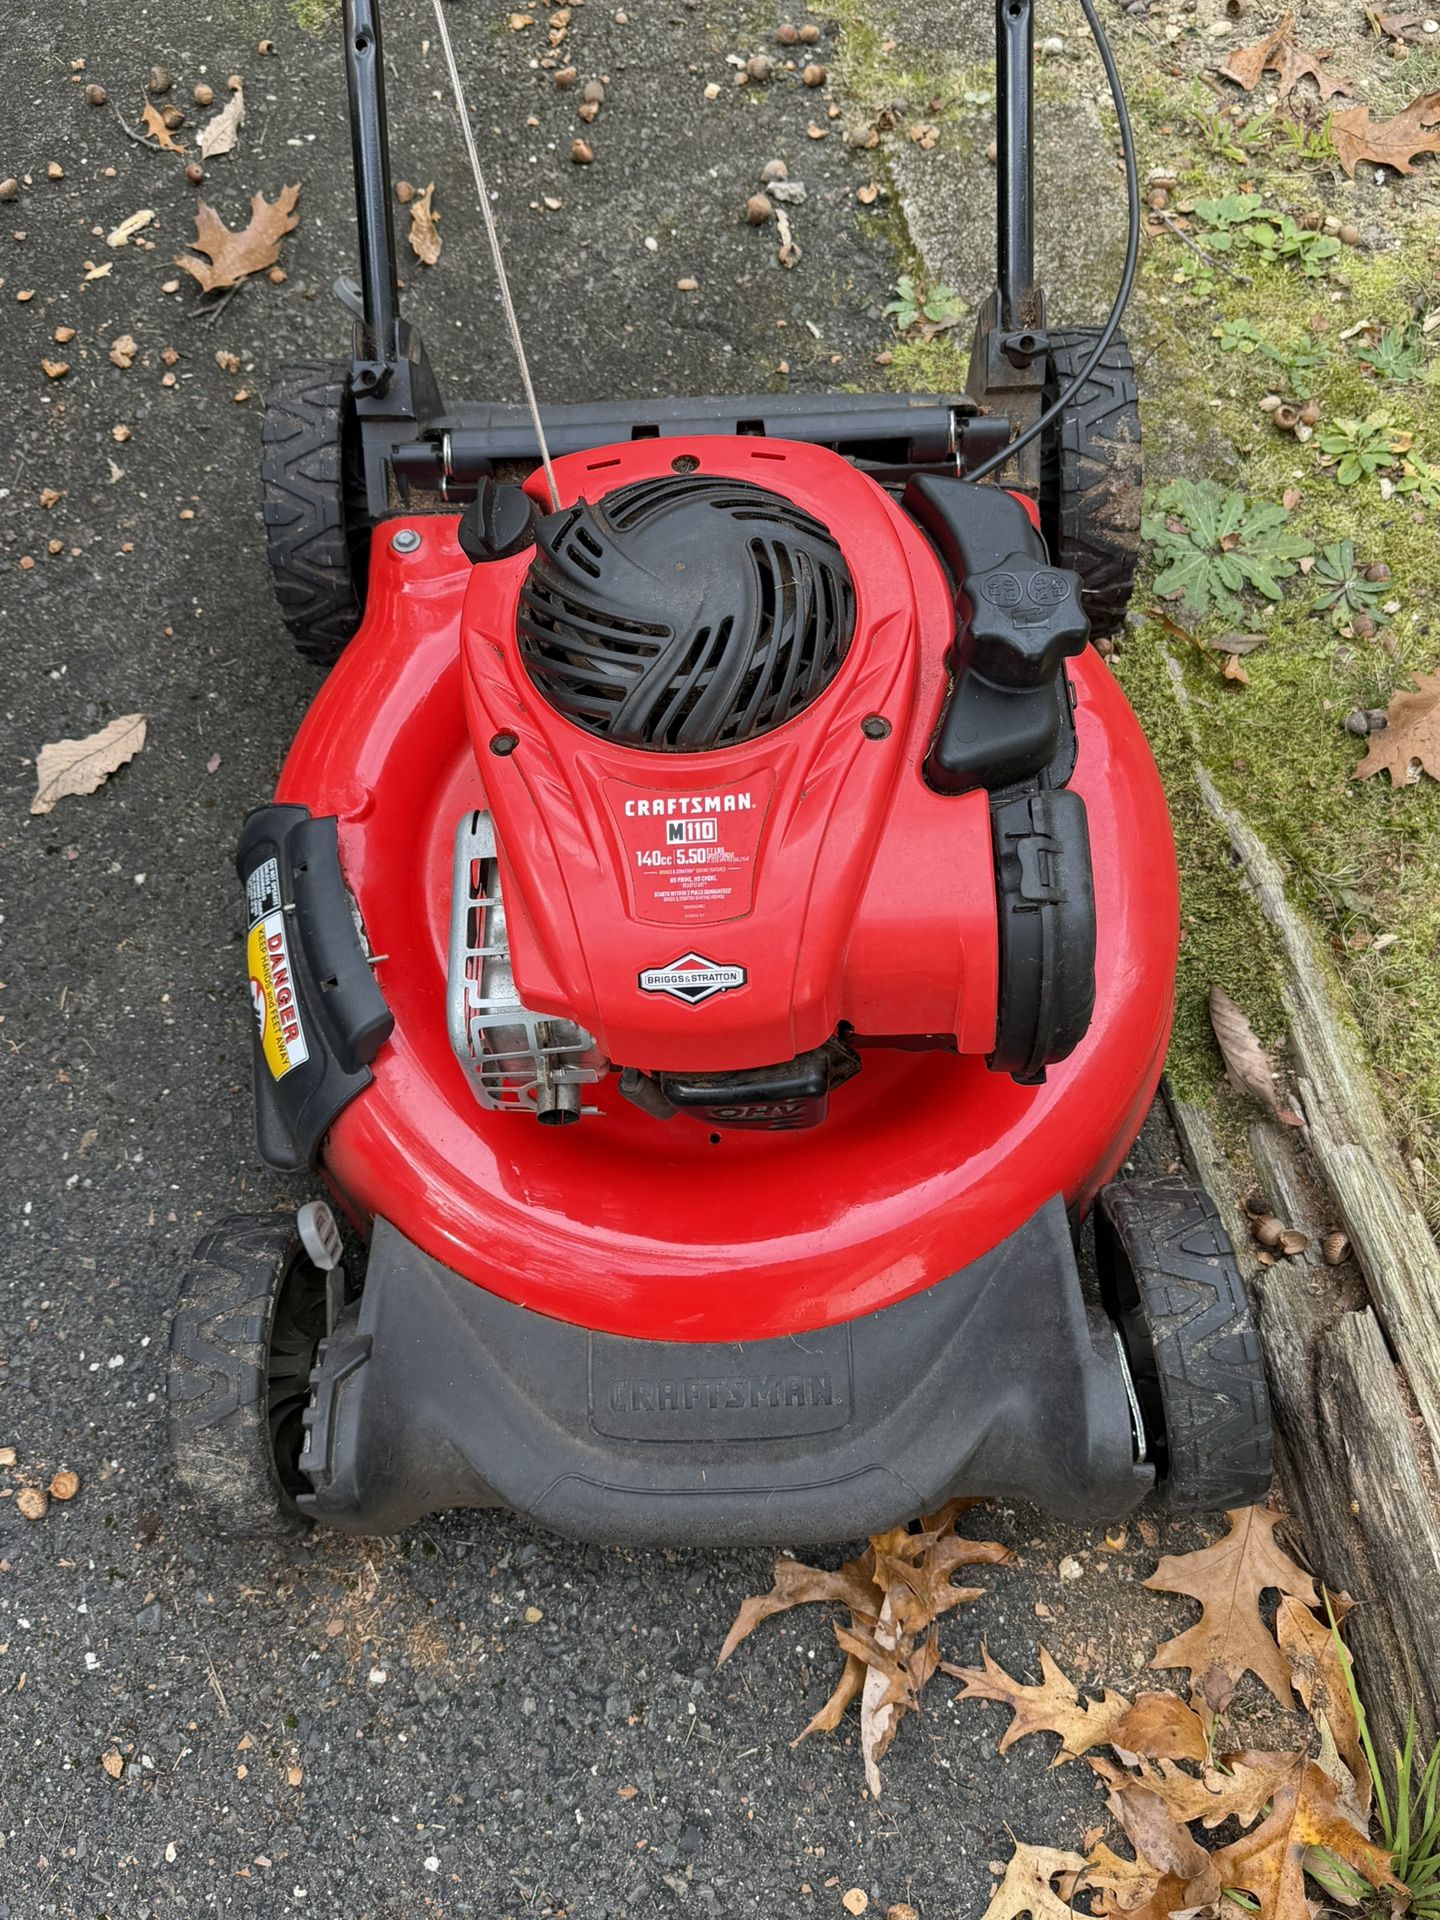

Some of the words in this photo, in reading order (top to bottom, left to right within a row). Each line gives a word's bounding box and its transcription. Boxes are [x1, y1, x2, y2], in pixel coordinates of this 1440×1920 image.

[624, 792, 751, 816] CRAFTSMAN
[668, 821, 713, 841] M110
[636, 850, 673, 867] 140cc
[675, 847, 706, 865] 5.50
[258, 929, 267, 954] KEEP
[261, 955, 272, 989] HANDS
[267, 933, 300, 1044] DANGER
[267, 991, 275, 1009] and
[271, 1009, 281, 1034] FEET
[276, 1036, 290, 1065] AWAY
[609, 1374, 833, 1412] CRAFTSMAN
